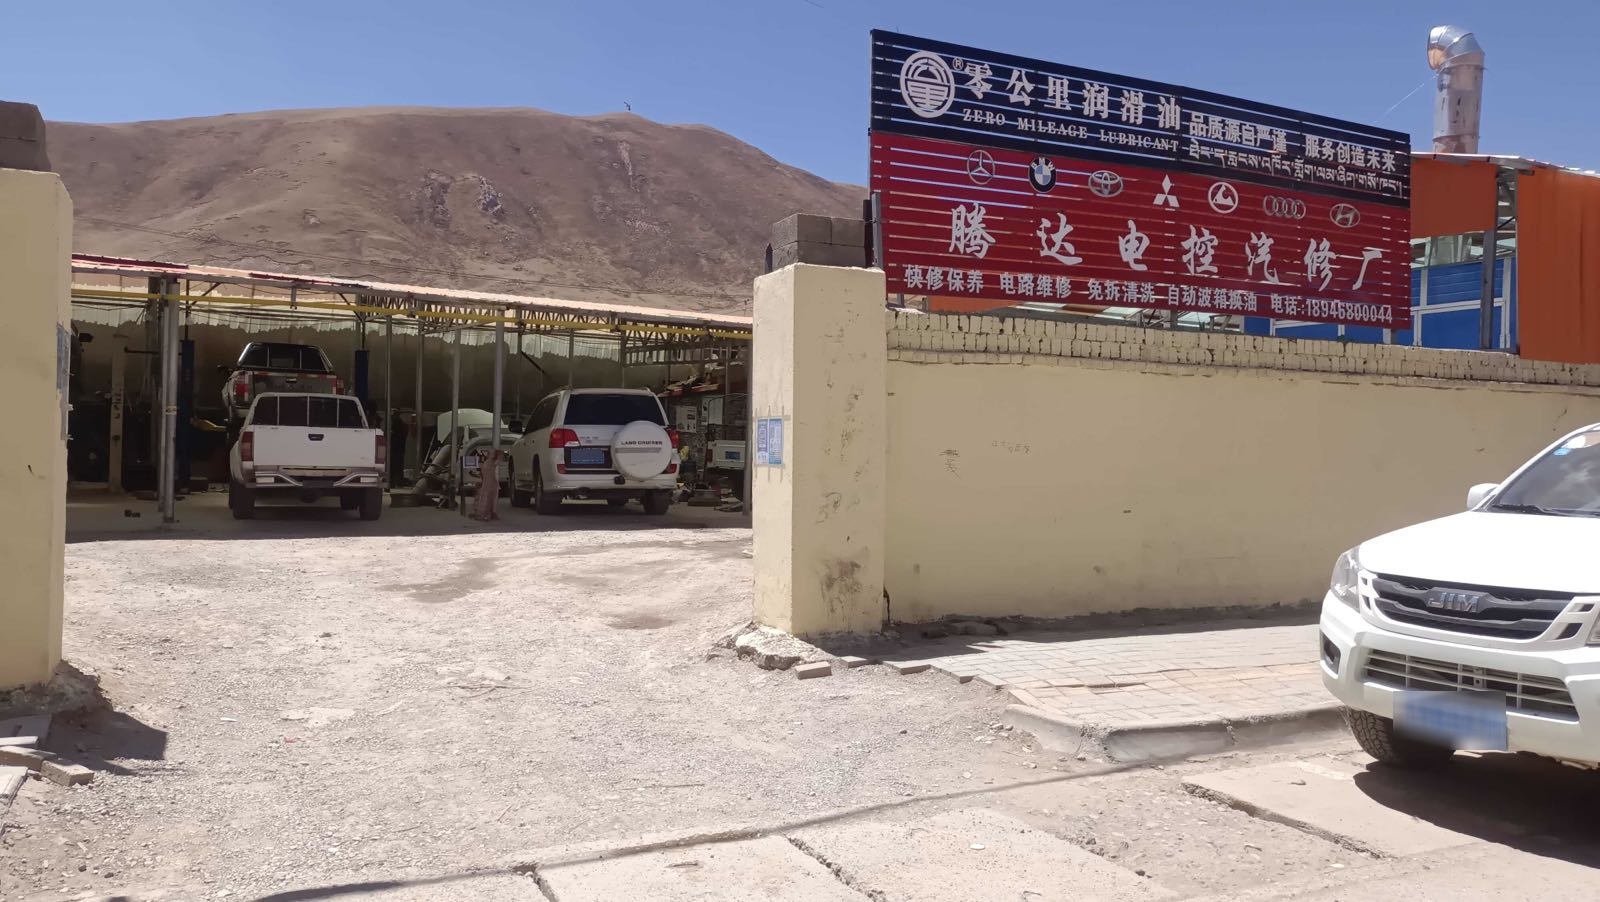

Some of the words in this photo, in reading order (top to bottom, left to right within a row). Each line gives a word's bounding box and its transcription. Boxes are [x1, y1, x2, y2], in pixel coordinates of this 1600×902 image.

[964, 62, 1181, 130] 零公里润滑油
[962, 108, 1006, 126] ZERO
[1017, 117, 1088, 139] MILEAGE
[1100, 129, 1179, 152] LUBRICANT
[1189, 111, 1288, 153] 品质源自严谨
[1305, 133, 1397, 172] 服务创造未来
[949, 202, 1382, 292] 腾达电控汽修厂
[904, 264, 984, 294] 快修保养
[999, 272, 1072, 299] 电路维修
[1087, 278, 1156, 303] 免拆清洗
[1168, 284, 1257, 312] 自动波箱换油
